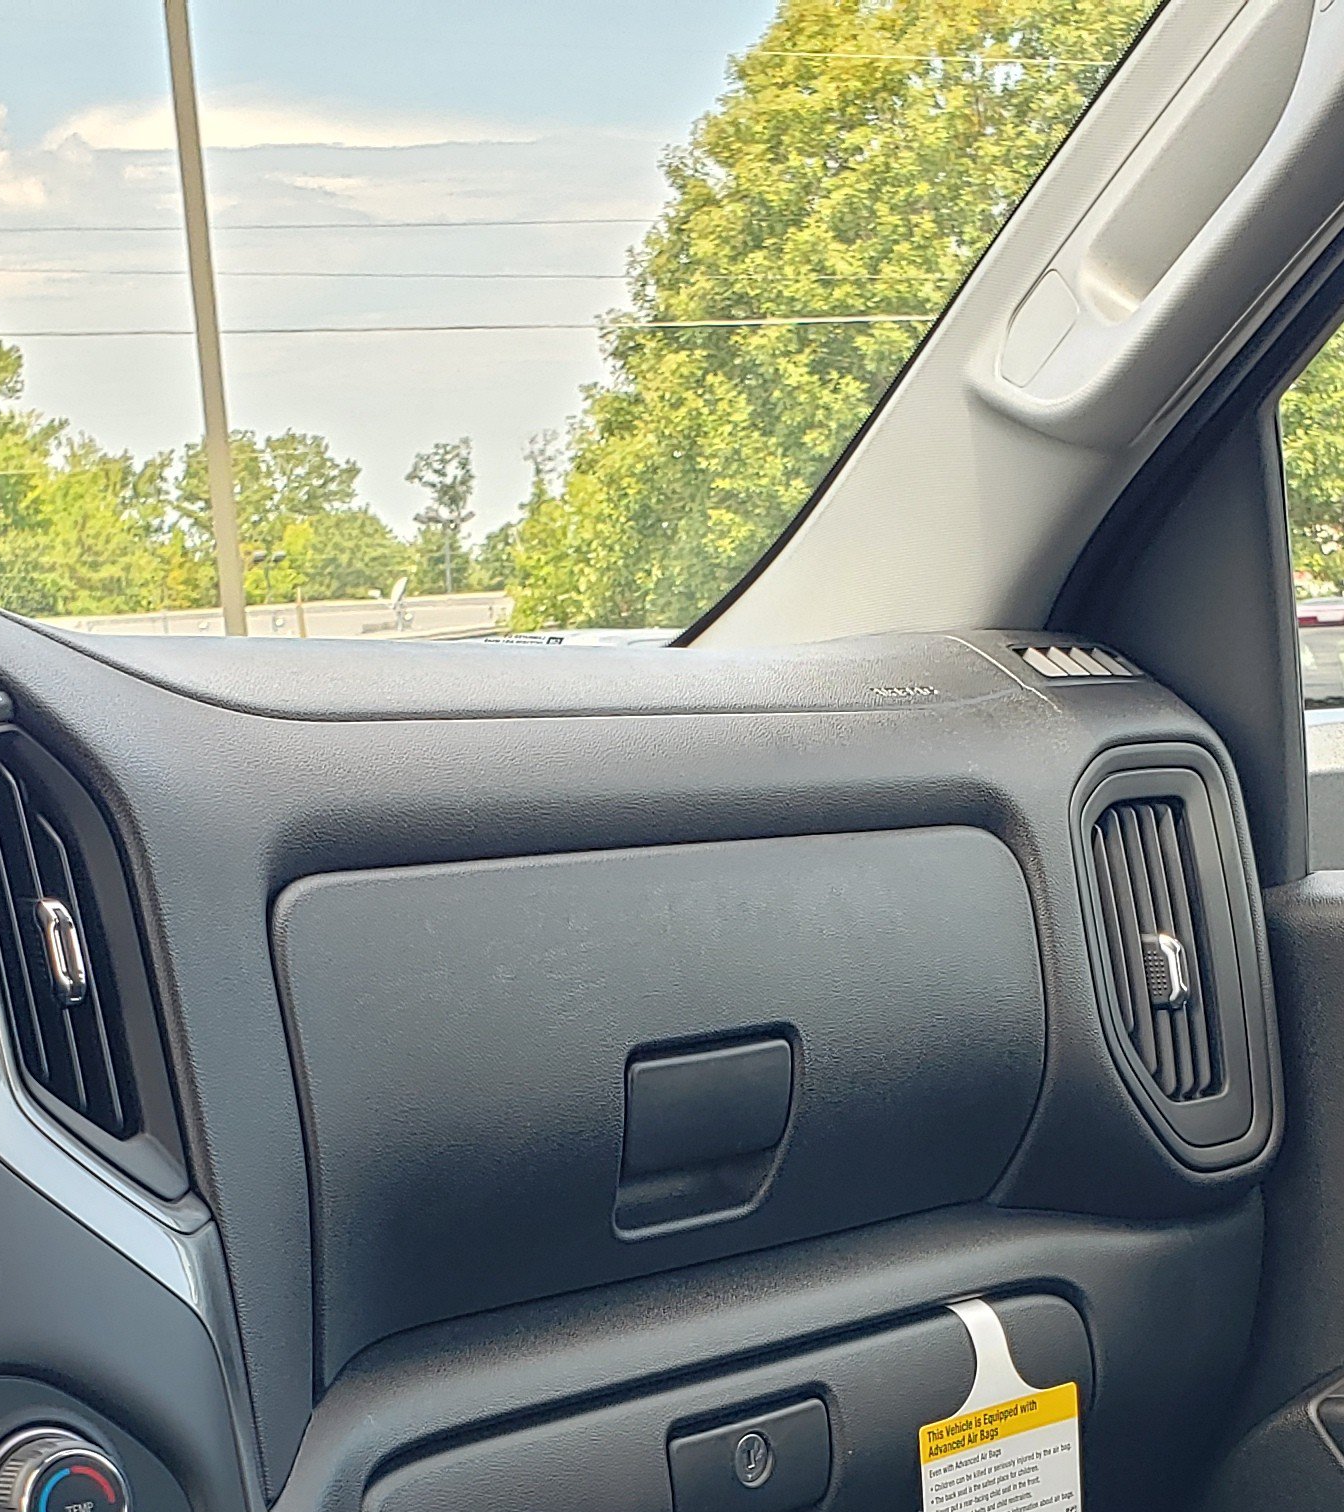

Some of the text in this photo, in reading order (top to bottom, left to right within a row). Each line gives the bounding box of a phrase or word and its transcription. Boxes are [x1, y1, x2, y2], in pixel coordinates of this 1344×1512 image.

[928, 1400, 1037, 1443] This Vehicle is Equipped with
[929, 1427, 999, 1457] Advanced Air Bags
[929, 1449, 1001, 1478] Even with Advanced Air Bags
[935, 1480, 955, 1492] Children
[956, 1477, 965, 1485] can
[1017, 1452, 1034, 1465] injured
